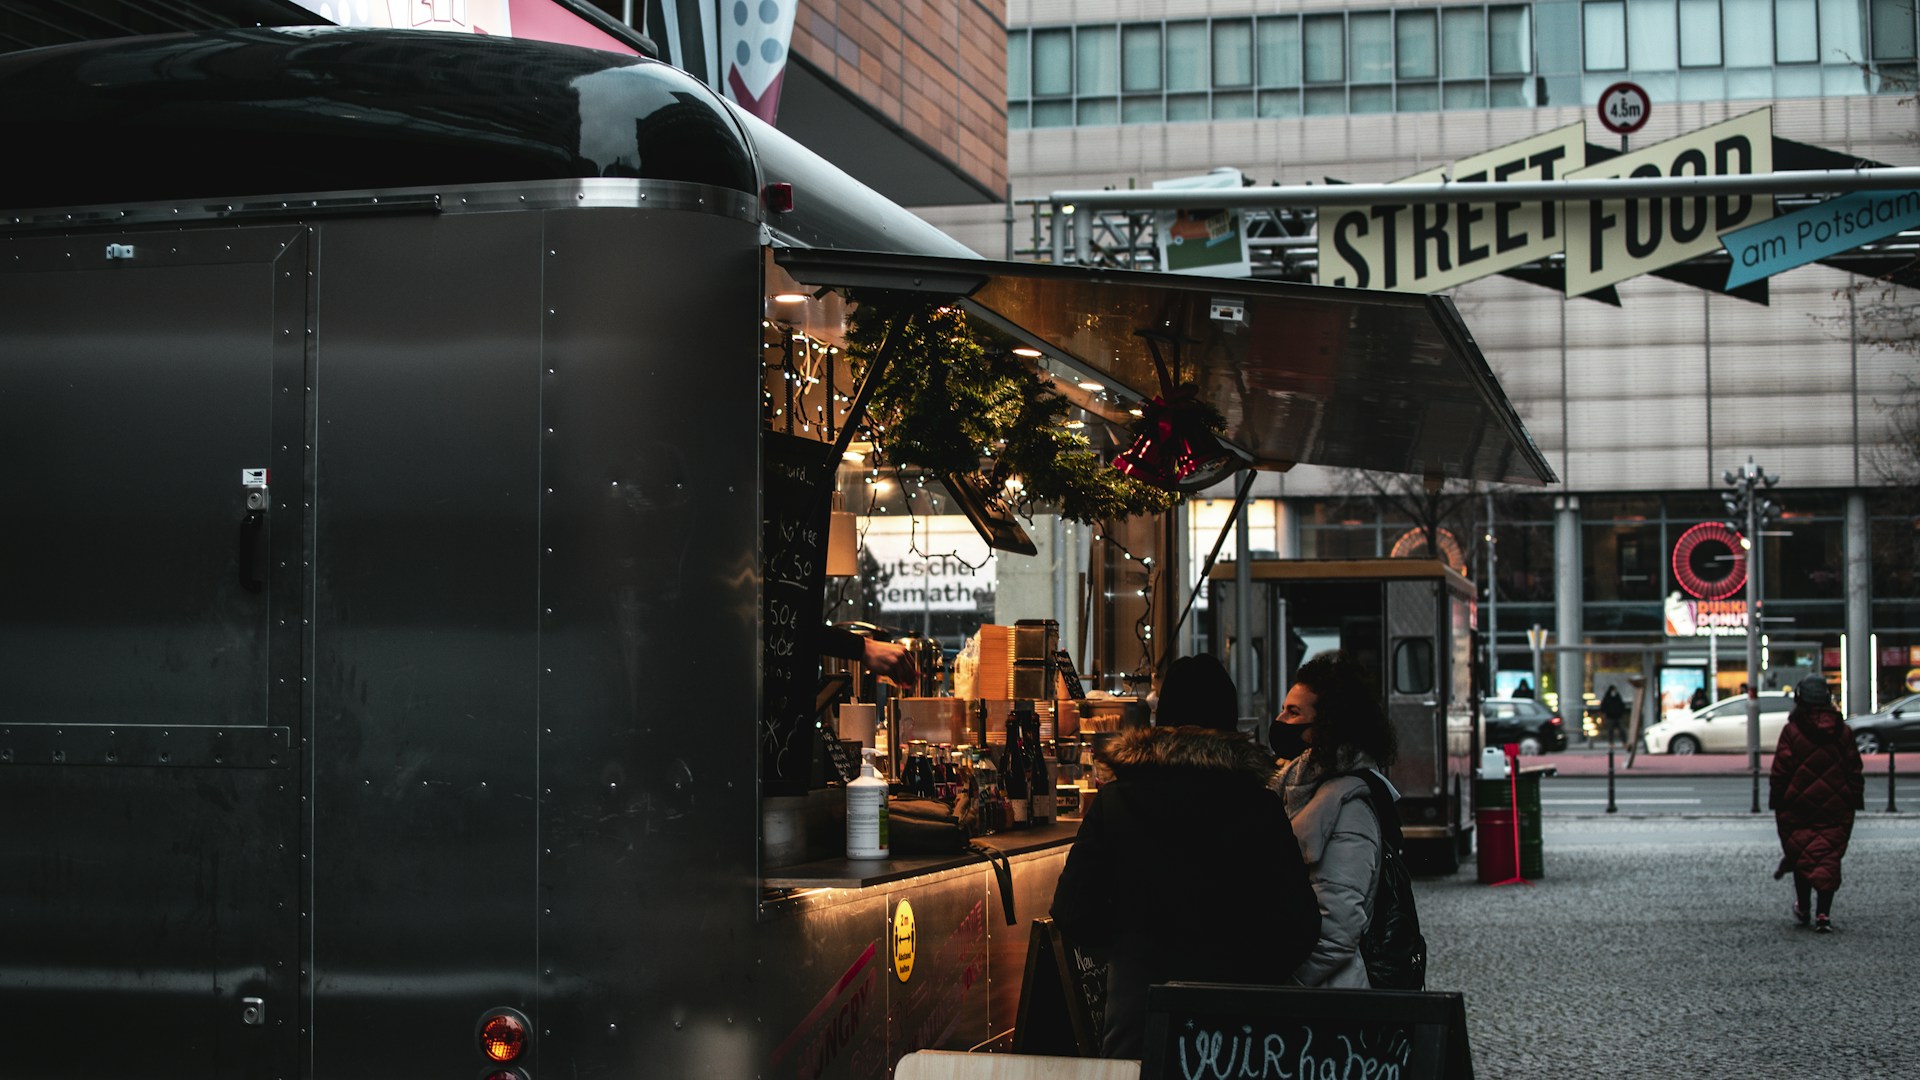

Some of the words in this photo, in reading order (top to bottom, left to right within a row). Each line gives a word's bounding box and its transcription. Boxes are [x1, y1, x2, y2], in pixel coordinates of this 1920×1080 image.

[1334, 145, 1565, 289] STREET
[1590, 134, 1752, 273] FOOD
[1742, 236, 1786, 267] am
[882, 555, 970, 576] utsche
[877, 582, 991, 602] nemathe
[1697, 613, 1761, 627] DONUT
